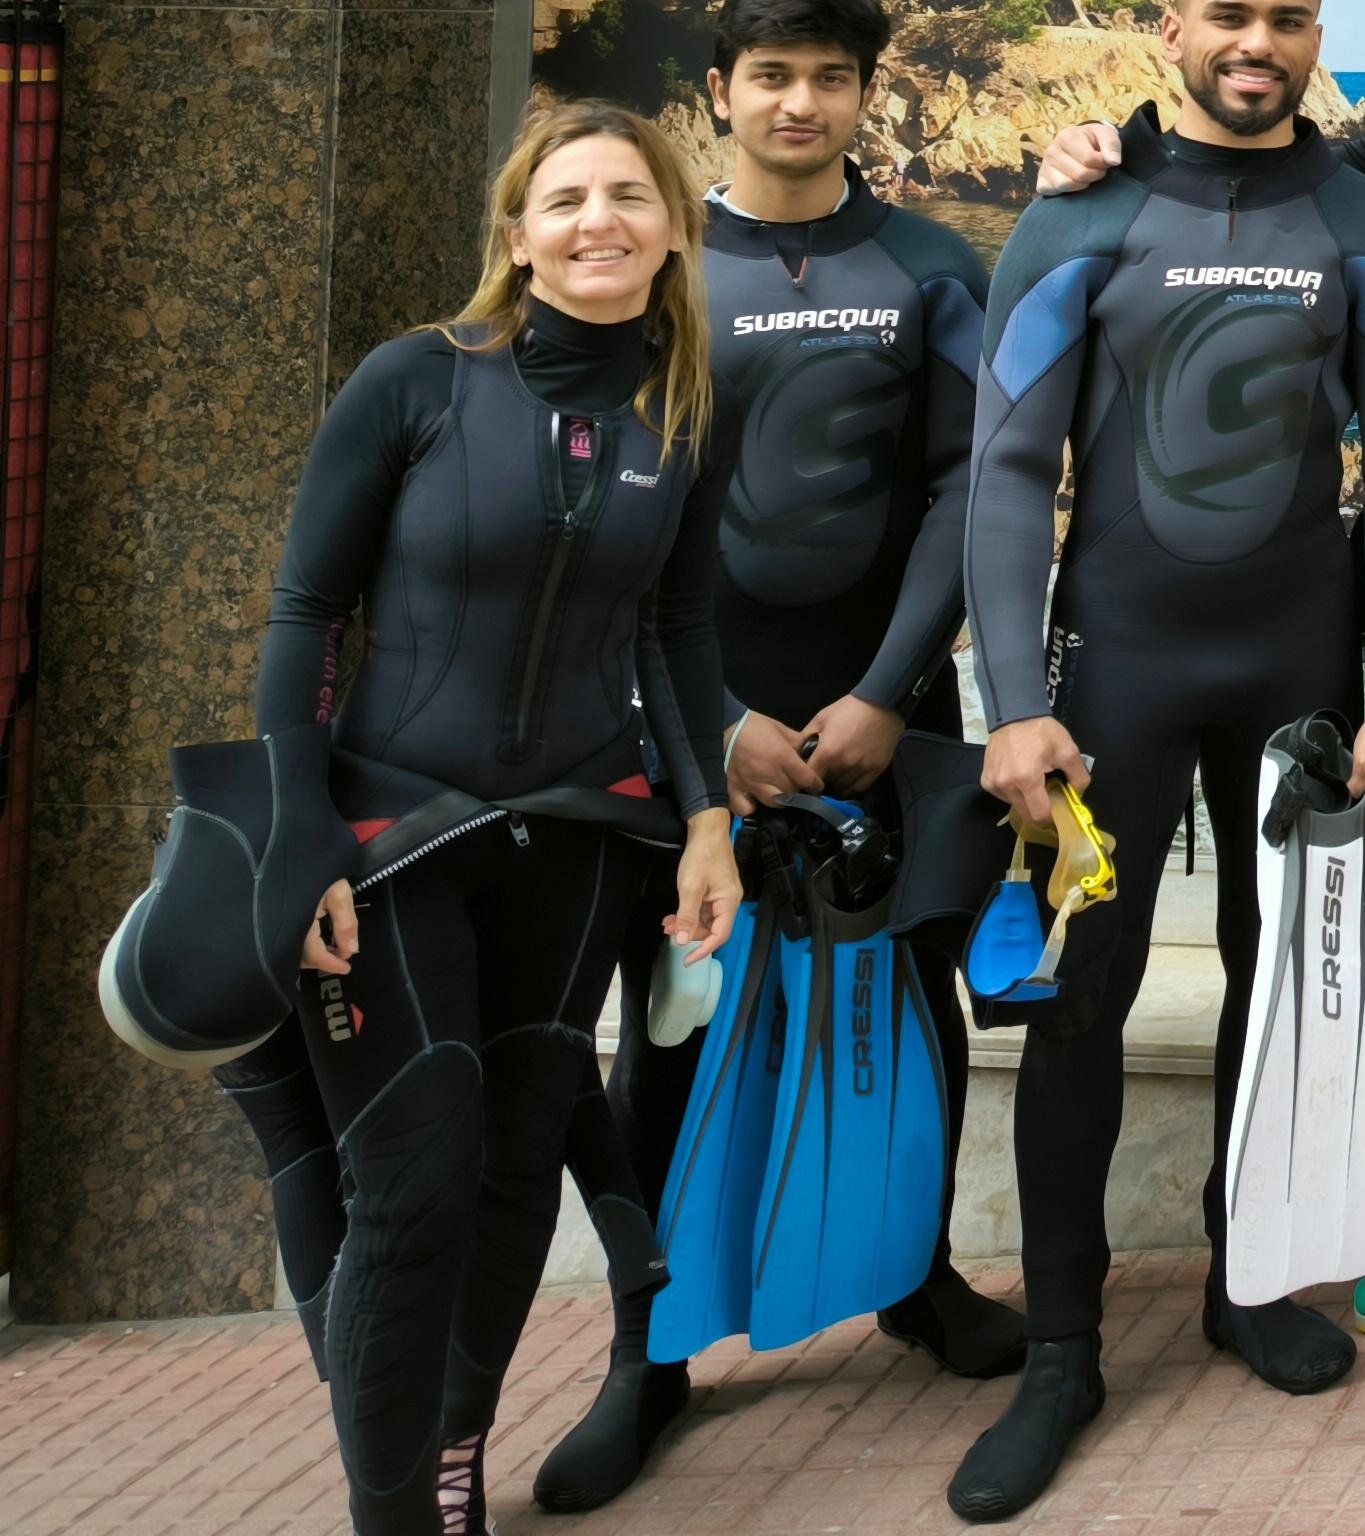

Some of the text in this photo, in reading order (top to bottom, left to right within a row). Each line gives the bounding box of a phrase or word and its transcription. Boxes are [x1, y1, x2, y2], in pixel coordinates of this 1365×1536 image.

[1164, 266, 1323, 290] SUBACQUA
[1225, 293, 1274, 305] ATLAS
[733, 308, 900, 336] SUBACQUA
[620, 469, 660, 485] Cressi
[1321, 855, 1346, 1021] CRESSI
[852, 947, 876, 1097] CRESSI
